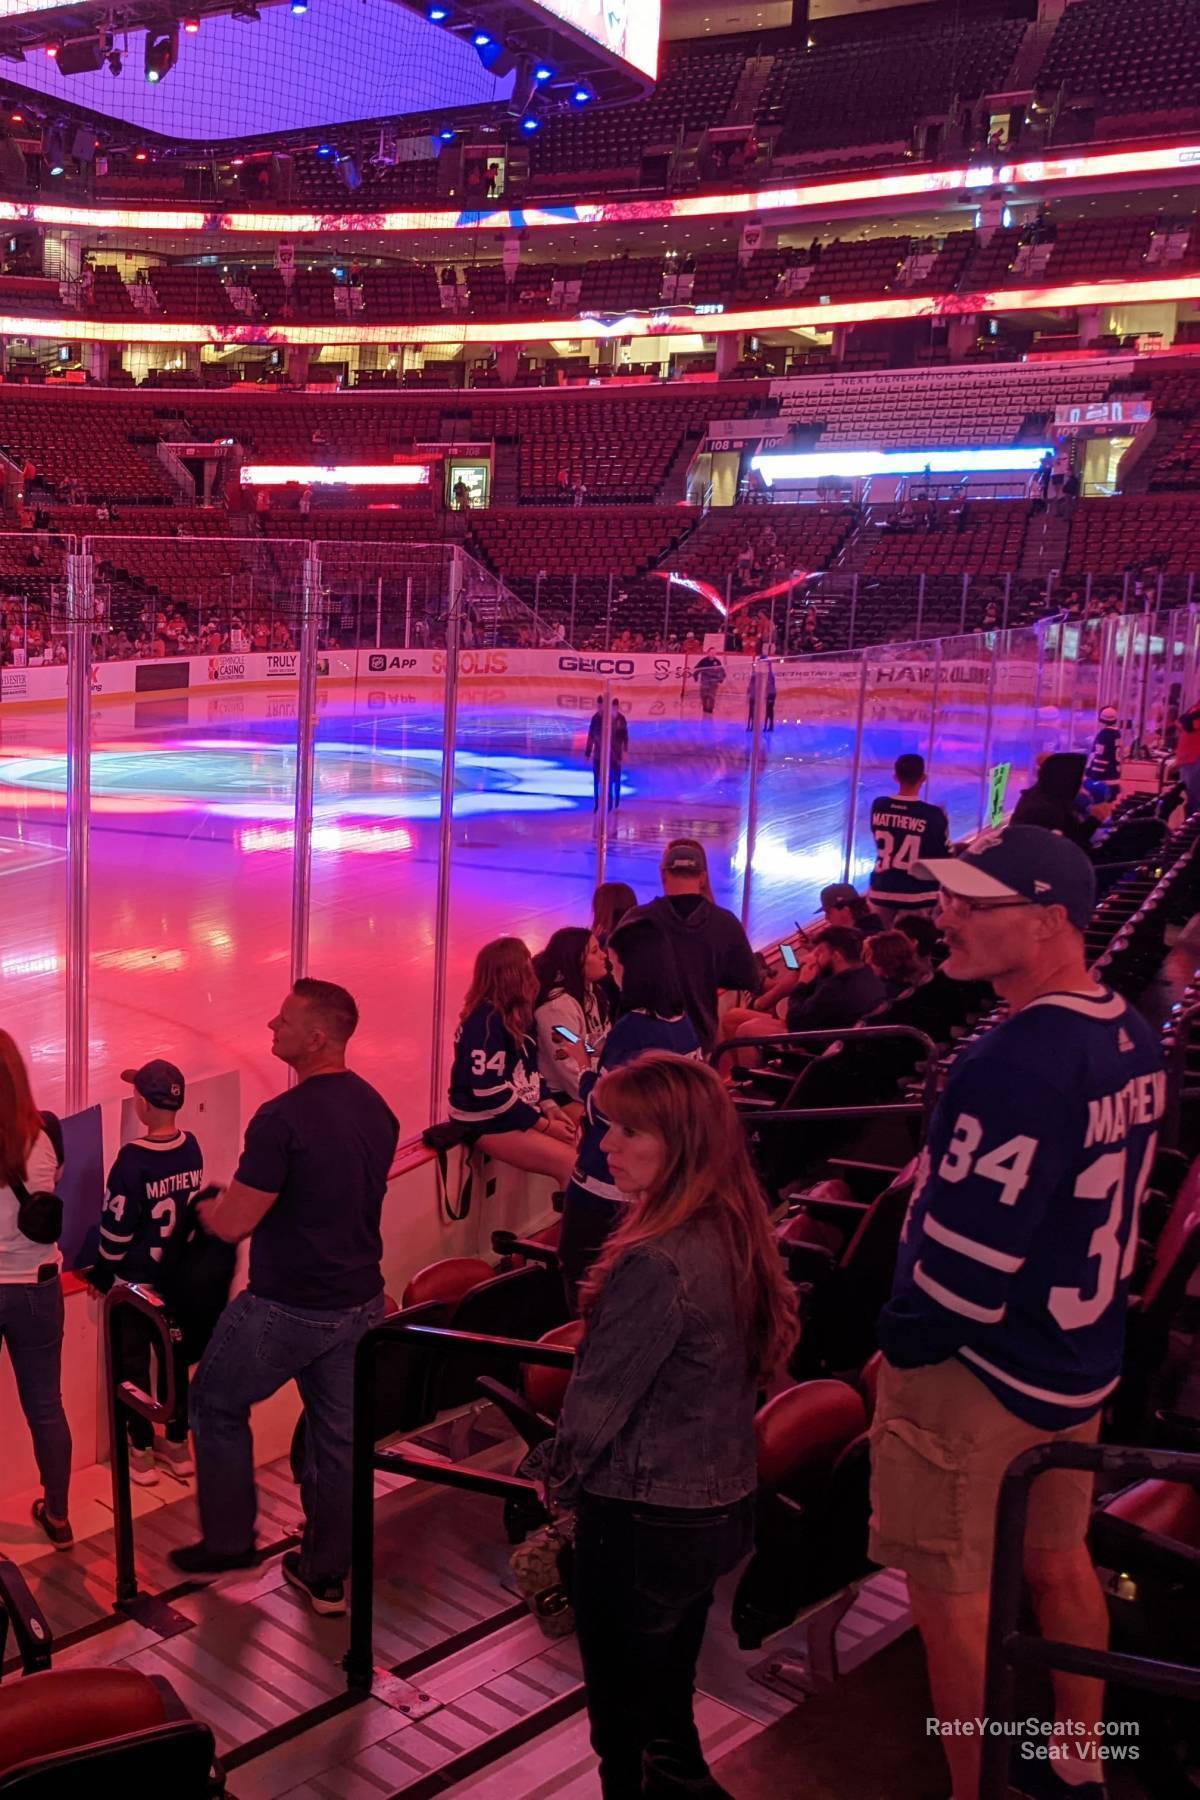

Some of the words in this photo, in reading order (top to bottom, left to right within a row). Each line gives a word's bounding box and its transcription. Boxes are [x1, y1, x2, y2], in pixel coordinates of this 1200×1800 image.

[841, 375, 871, 386] NEXT
[875, 372, 953, 384] GENERATION
[958, 370, 972, 379] OF
[1056, 426, 1079, 438] 109
[711, 440, 730, 451] 108
[266, 655, 297, 667] TRULY
[558, 656, 635, 675] GEICO
[219, 664, 245, 676] CASINO
[872, 812, 927, 833] MATTHEWS
[874, 830, 923, 874] 34
[470, 1049, 506, 1077] 34
[937, 1112, 1039, 1207] 34
